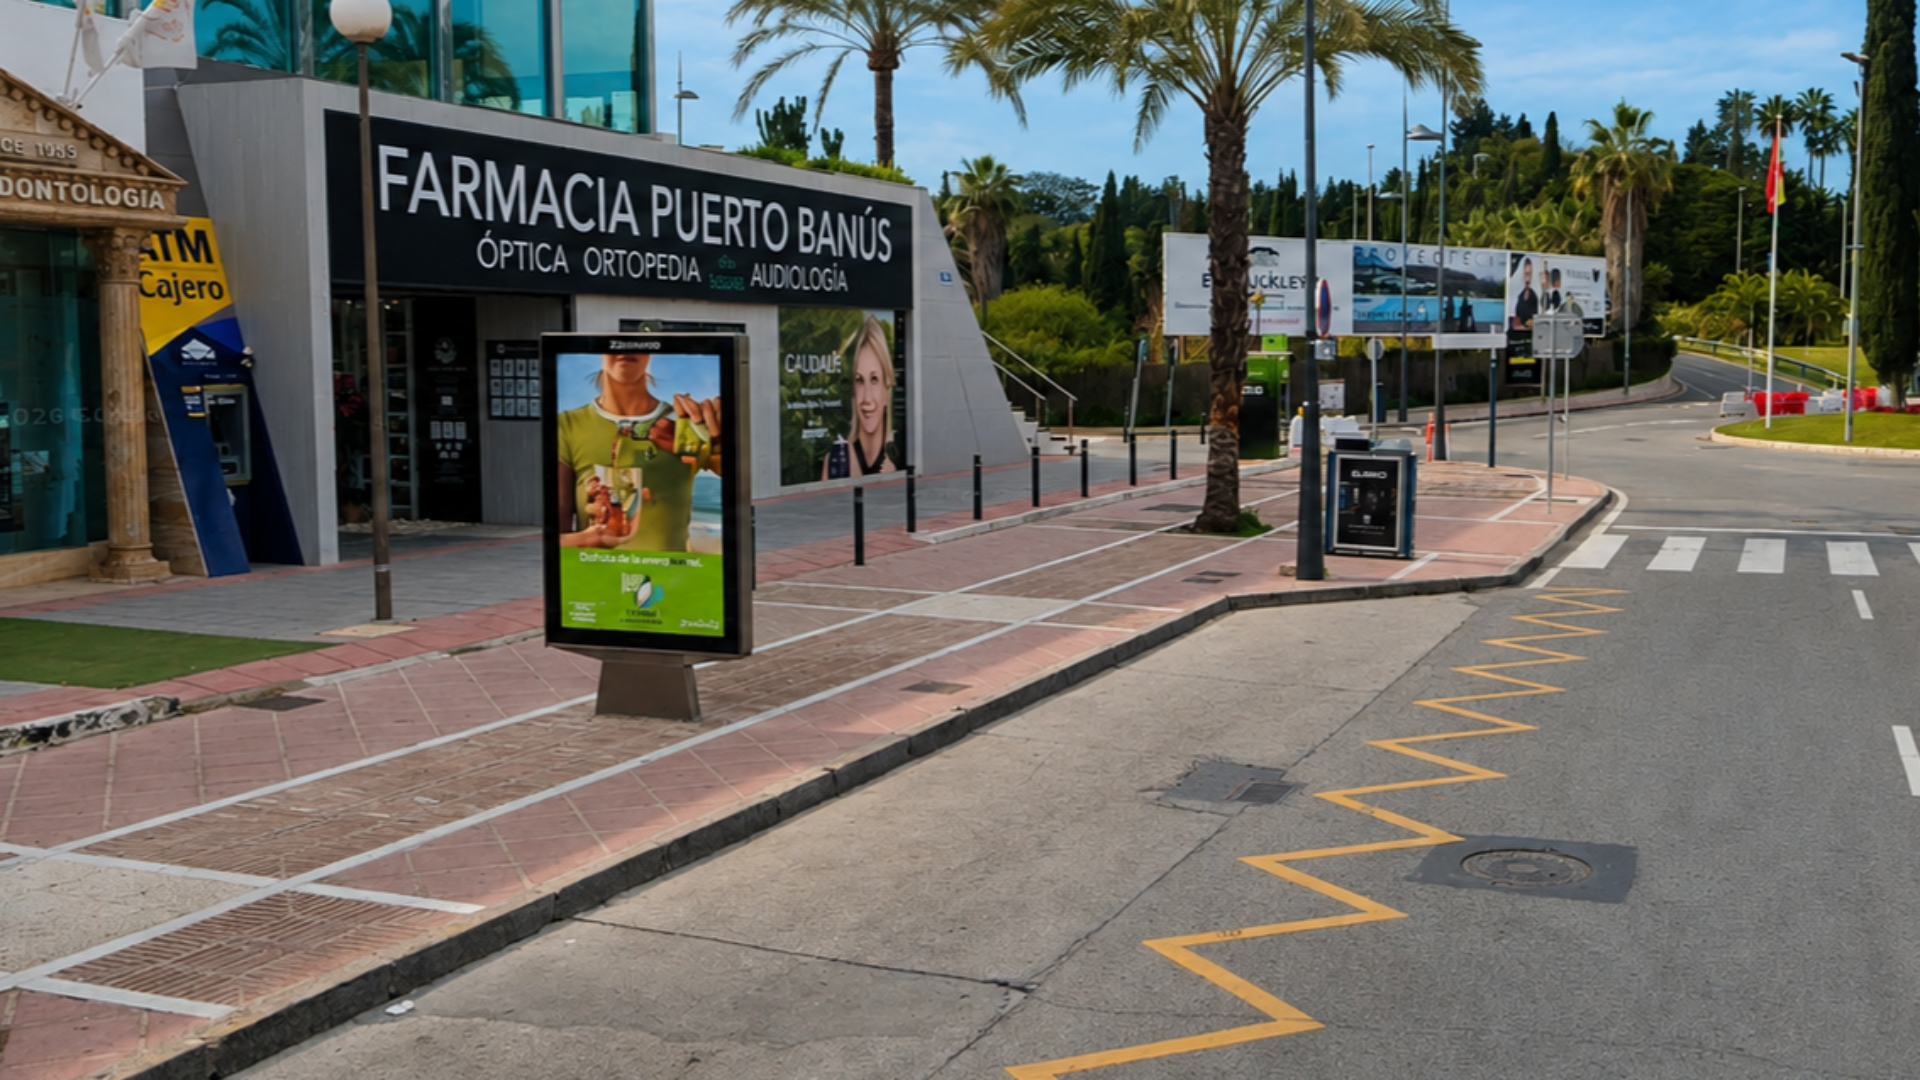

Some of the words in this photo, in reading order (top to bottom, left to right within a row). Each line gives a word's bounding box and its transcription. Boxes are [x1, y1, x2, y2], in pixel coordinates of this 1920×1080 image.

[378, 144, 641, 237] FARMACIA
[651, 184, 789, 253] PUERTO
[798, 206, 893, 263] BANÚS
[476, 229, 570, 274] ÓPTICA
[583, 245, 702, 283] ORTOPEDIA
[139, 270, 225, 306] Cajero
